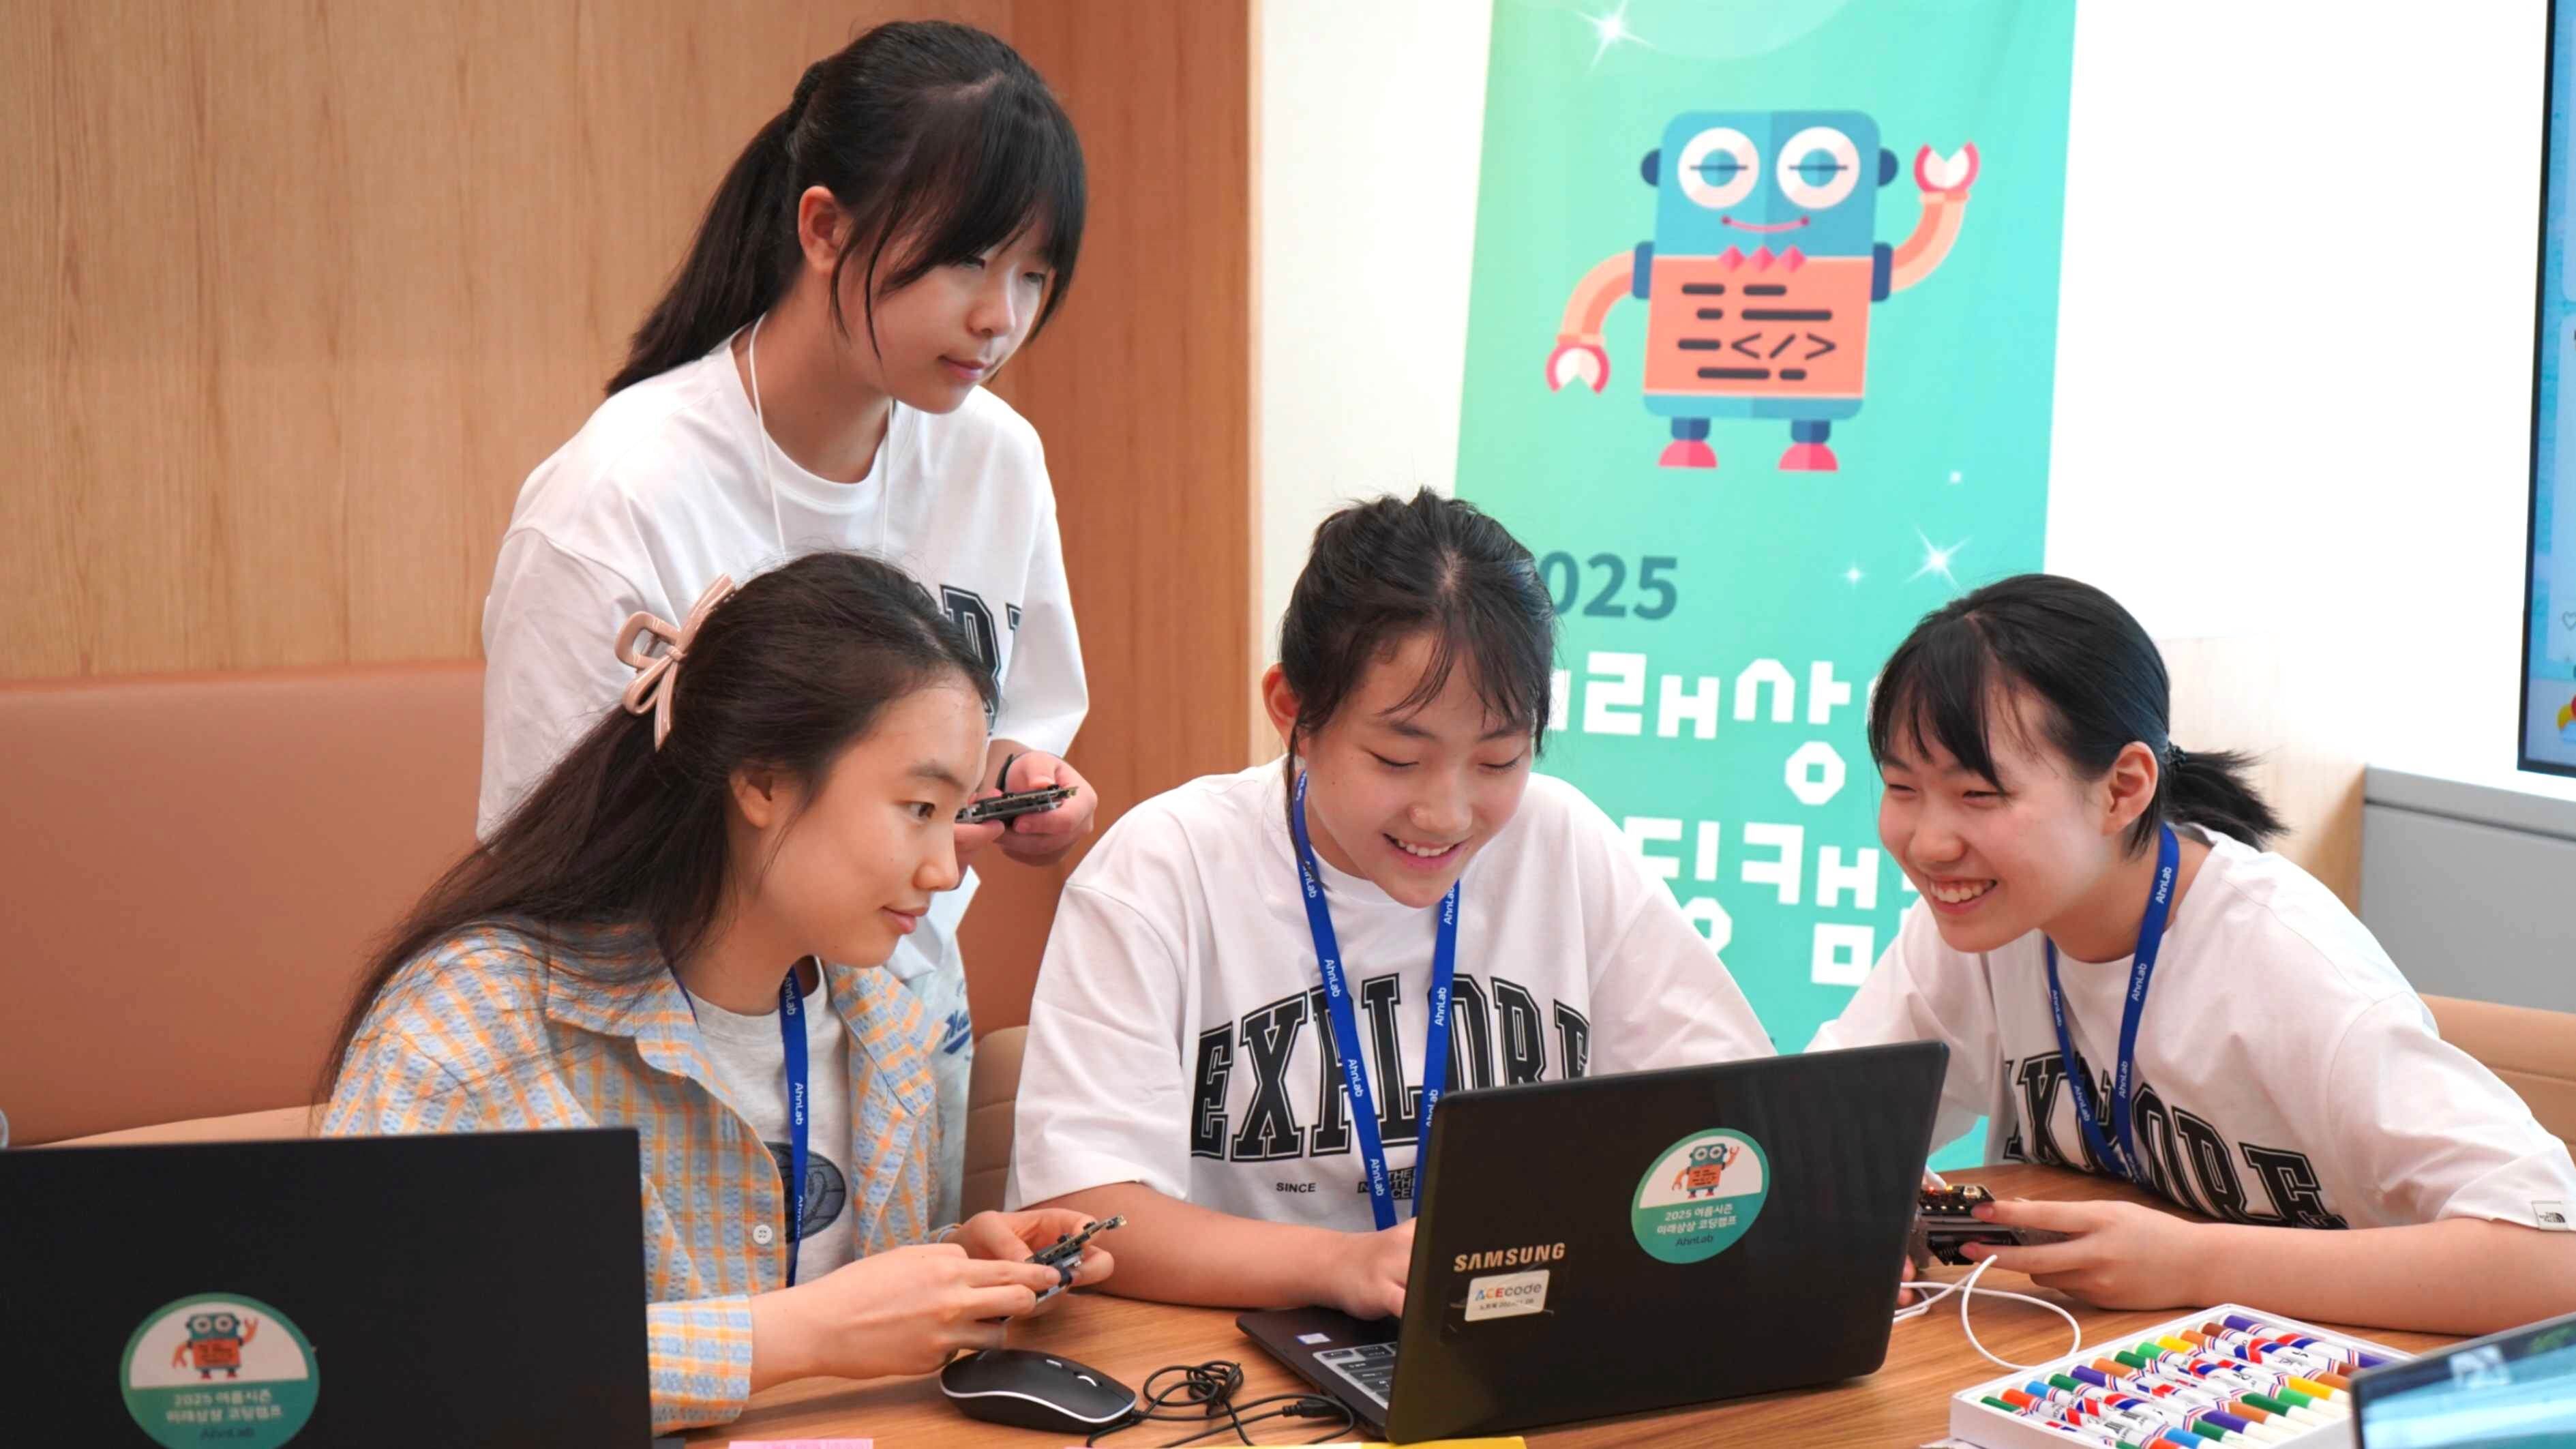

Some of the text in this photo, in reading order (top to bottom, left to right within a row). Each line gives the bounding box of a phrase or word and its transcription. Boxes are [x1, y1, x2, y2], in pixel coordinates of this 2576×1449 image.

[1538, 551, 1679, 621] 025
[1548, 651, 1878, 806] 래상
[1623, 816, 1921, 987] 딩캠
[2155, 866, 2172, 904] AhnLab
[1324, 959, 1341, 998] AhnLab
[2131, 963, 2148, 1002] AhnLab
[1434, 987, 1447, 1026] AhnLab
[1347, 1058, 1364, 1097] AhnLab
[2118, 1060, 2129, 1099] AhnLab
[794, 1081, 804, 1125] AhnLab
[1276, 1182, 1316, 1193] SINCE
[1370, 1158, 1385, 1197] AhnLab
[1664, 1209, 1692, 1221] 2025
[1453, 1242, 1566, 1273] SAMSUNG
[1675, 1234, 1713, 1246] AhnLab
[1475, 1283, 1542, 1302] ACEcode
